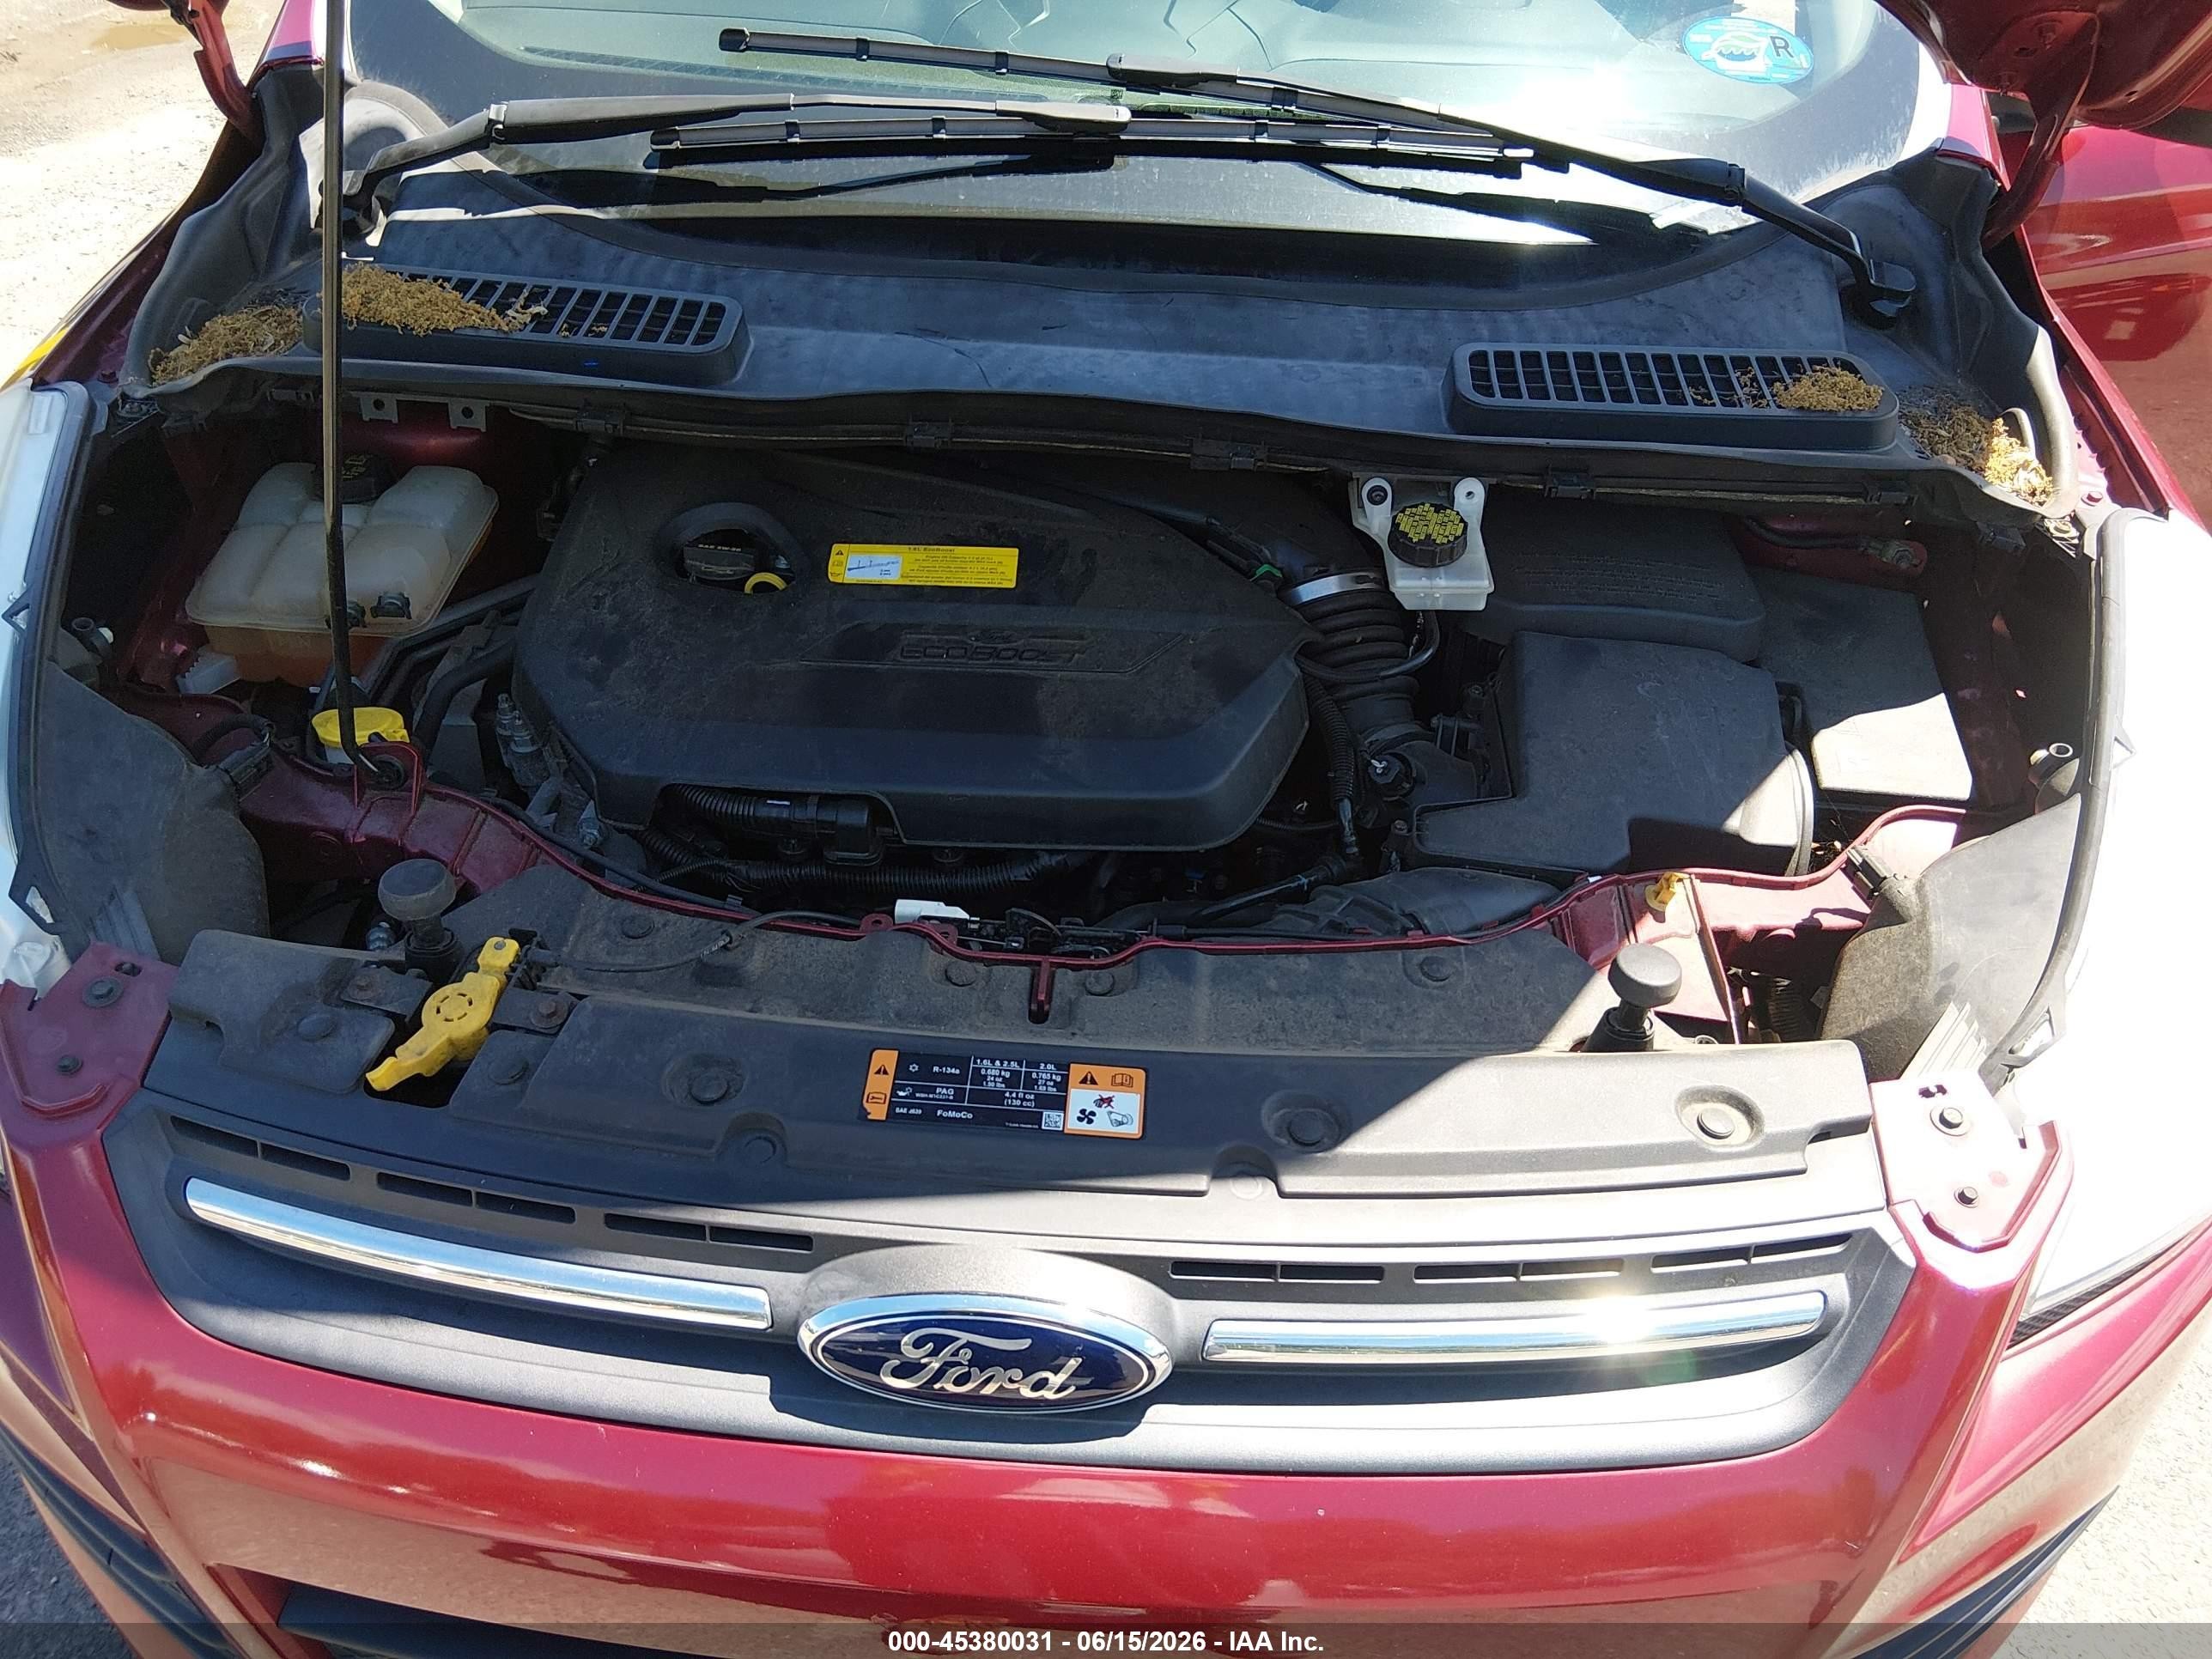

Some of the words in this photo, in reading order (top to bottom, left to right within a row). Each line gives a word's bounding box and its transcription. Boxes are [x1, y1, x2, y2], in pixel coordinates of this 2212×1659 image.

[1769, 35, 1795, 58] R
[933, 1066, 960, 1074] R-134a
[1001, 1069, 1011, 1078] kg
[1052, 1073, 1061, 1082] kg
[937, 1109, 974, 1119] FoMoCo
[879, 1327, 1082, 1401] Ford
